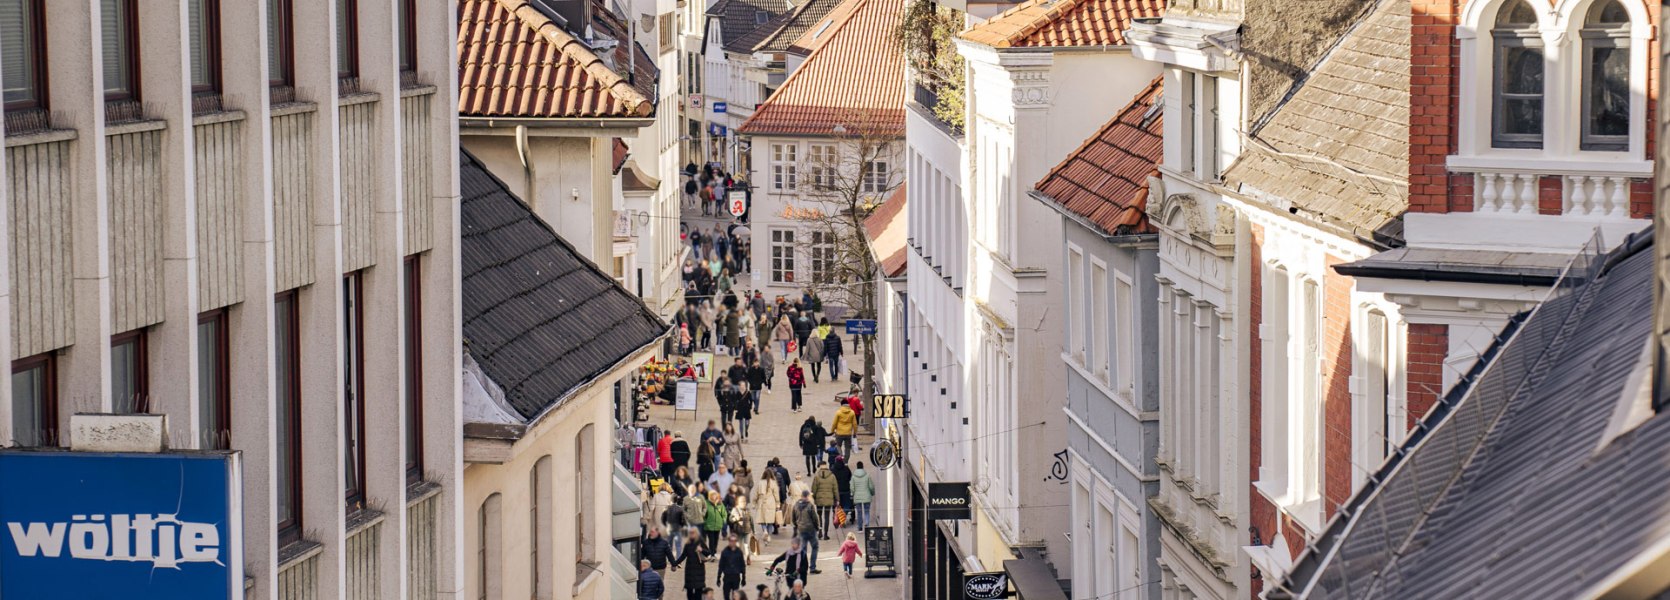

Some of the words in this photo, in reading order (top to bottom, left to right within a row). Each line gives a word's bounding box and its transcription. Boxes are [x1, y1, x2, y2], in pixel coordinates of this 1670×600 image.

[874, 395, 904, 418] SØR
[932, 497, 965, 505] MANGO
[7, 513, 221, 568] wöltje
